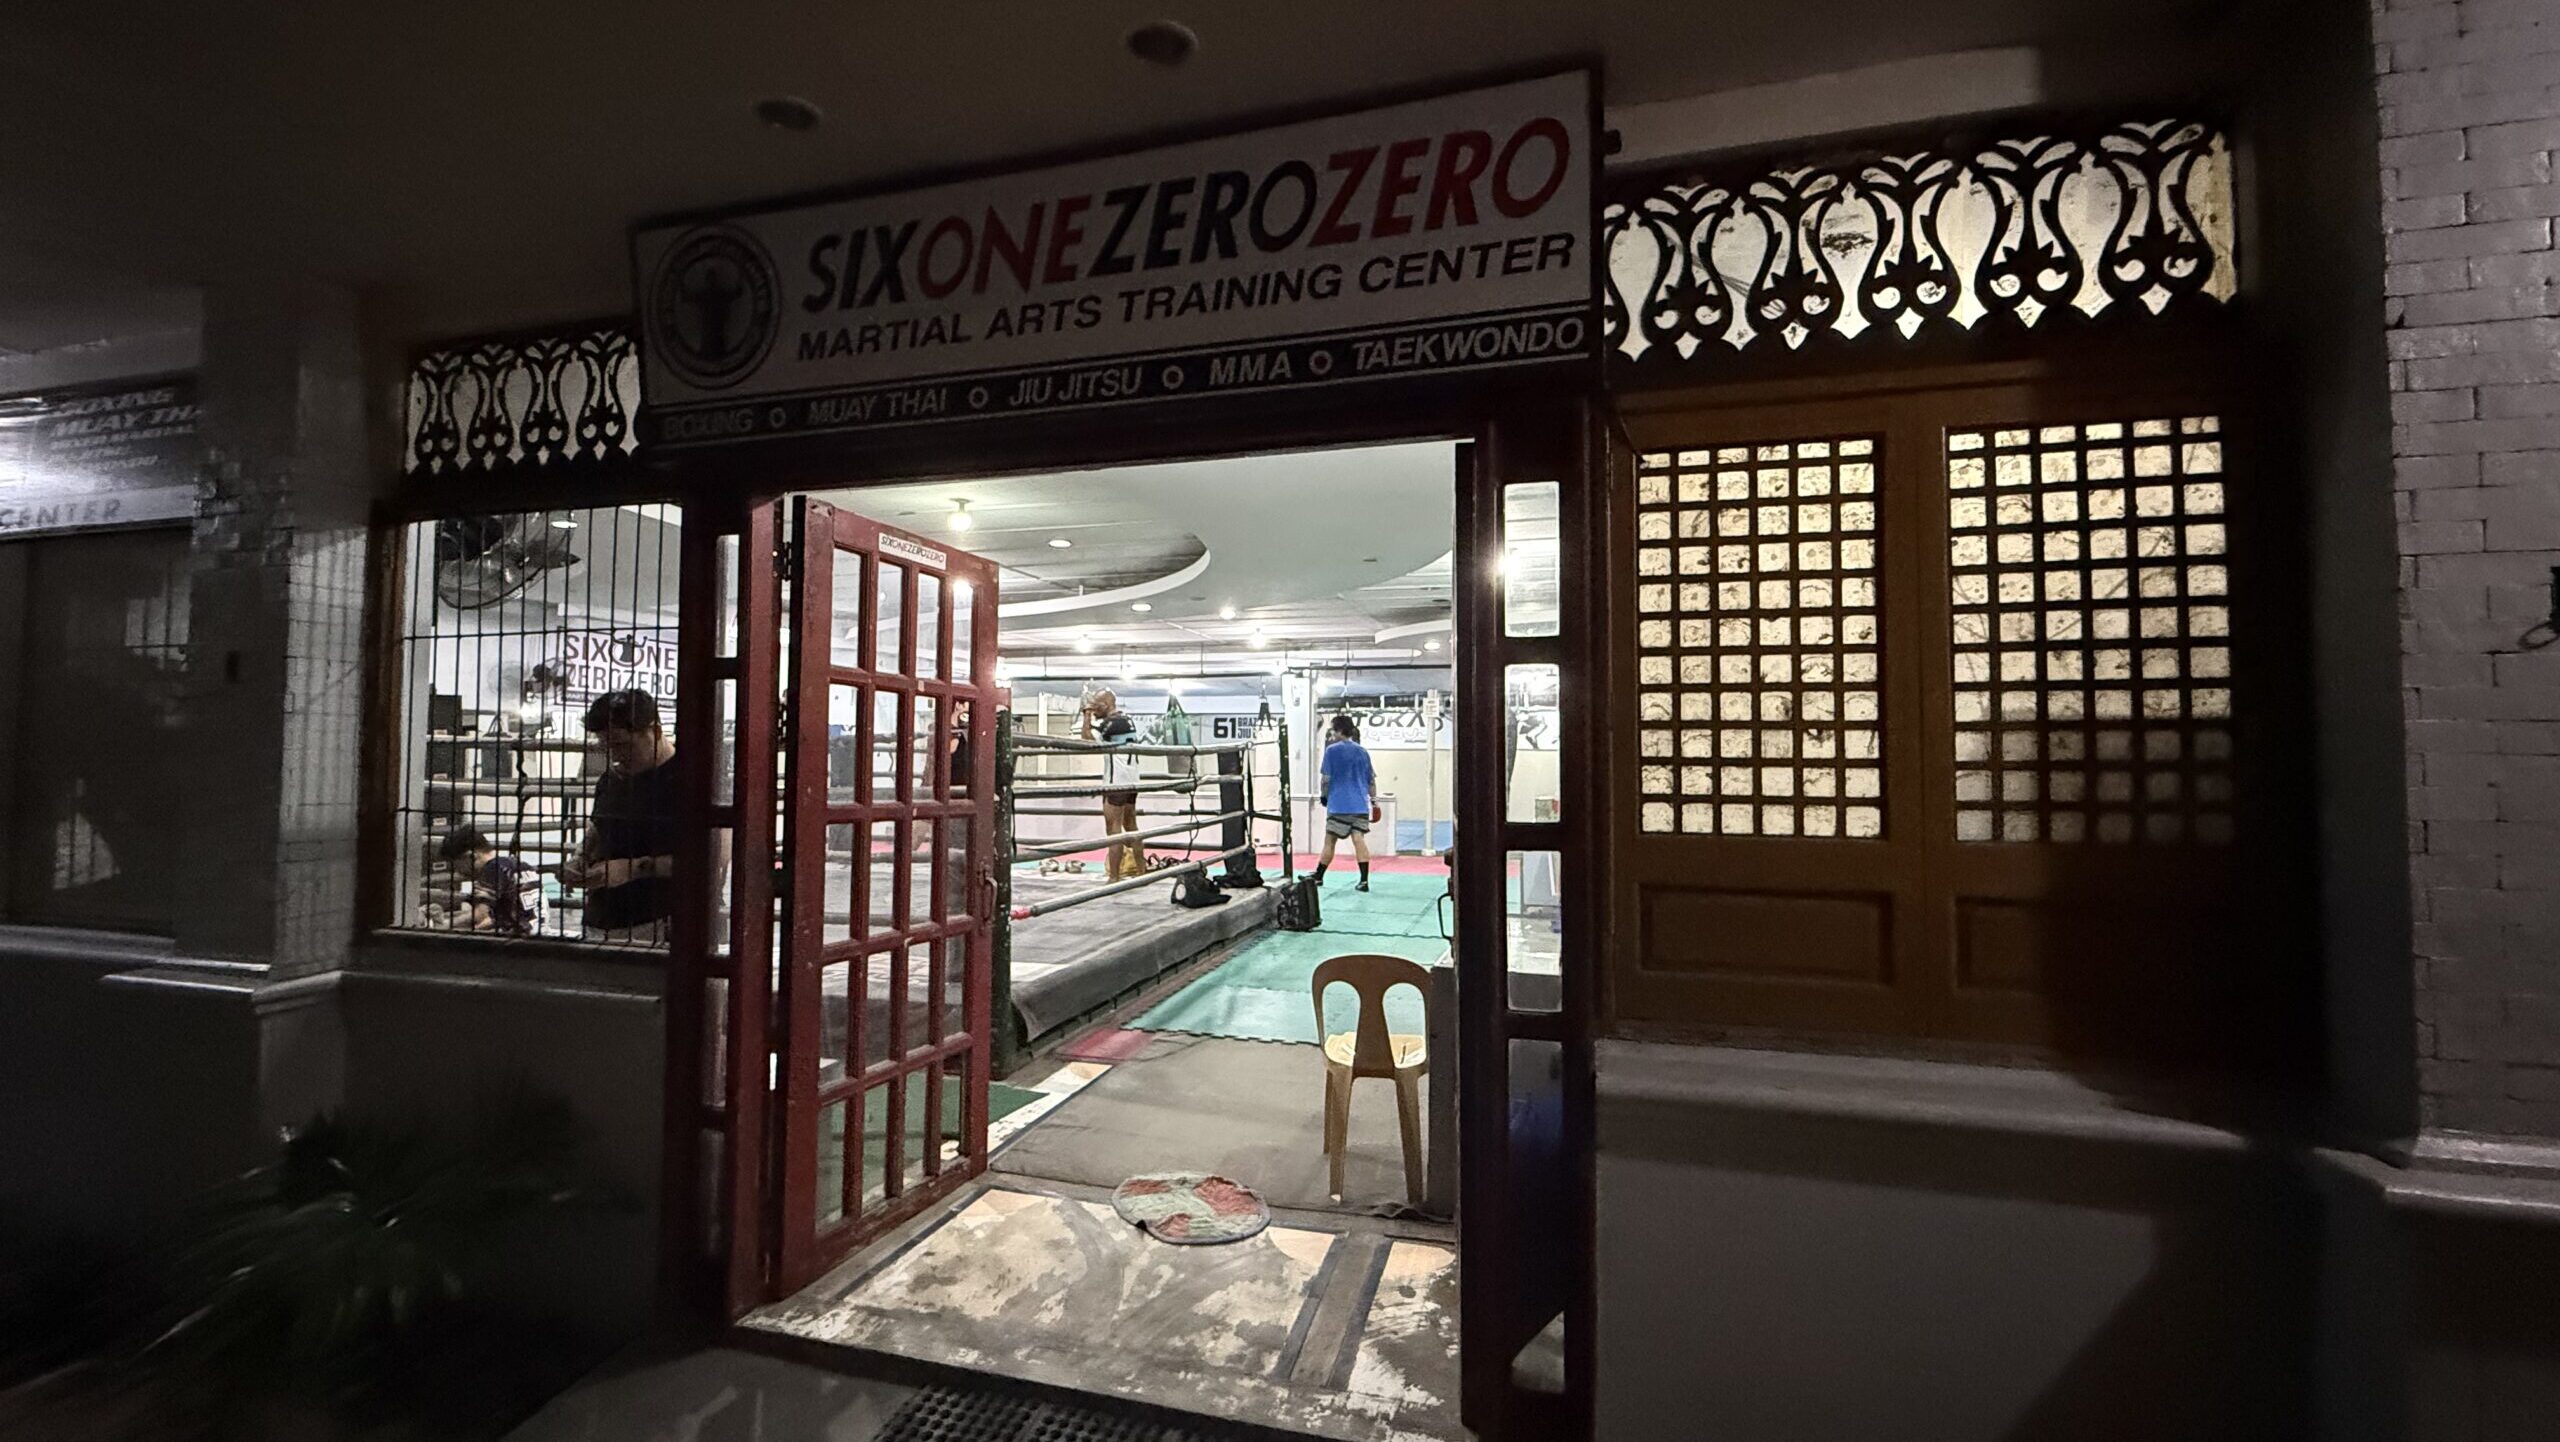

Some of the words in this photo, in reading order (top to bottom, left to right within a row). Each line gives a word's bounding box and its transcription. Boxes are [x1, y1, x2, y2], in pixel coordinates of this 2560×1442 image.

[802, 118, 1570, 313] SIXONEZEROZERO
[798, 313, 971, 361] MARTIAL
[985, 296, 1101, 342] ARTS
[1118, 263, 1342, 322] TRAINING
[1359, 232, 1575, 293] CENTER
[664, 408, 753, 440] BOXING
[808, 396, 877, 426] MUAY
[887, 388, 948, 418] THAI
[1010, 375, 1051, 406] JIU
[1056, 366, 1143, 401] JITSU
[1208, 349, 1292, 386] MMA
[1352, 316, 1585, 371] TAEKWONDO
[1213, 716, 1237, 739] 61
